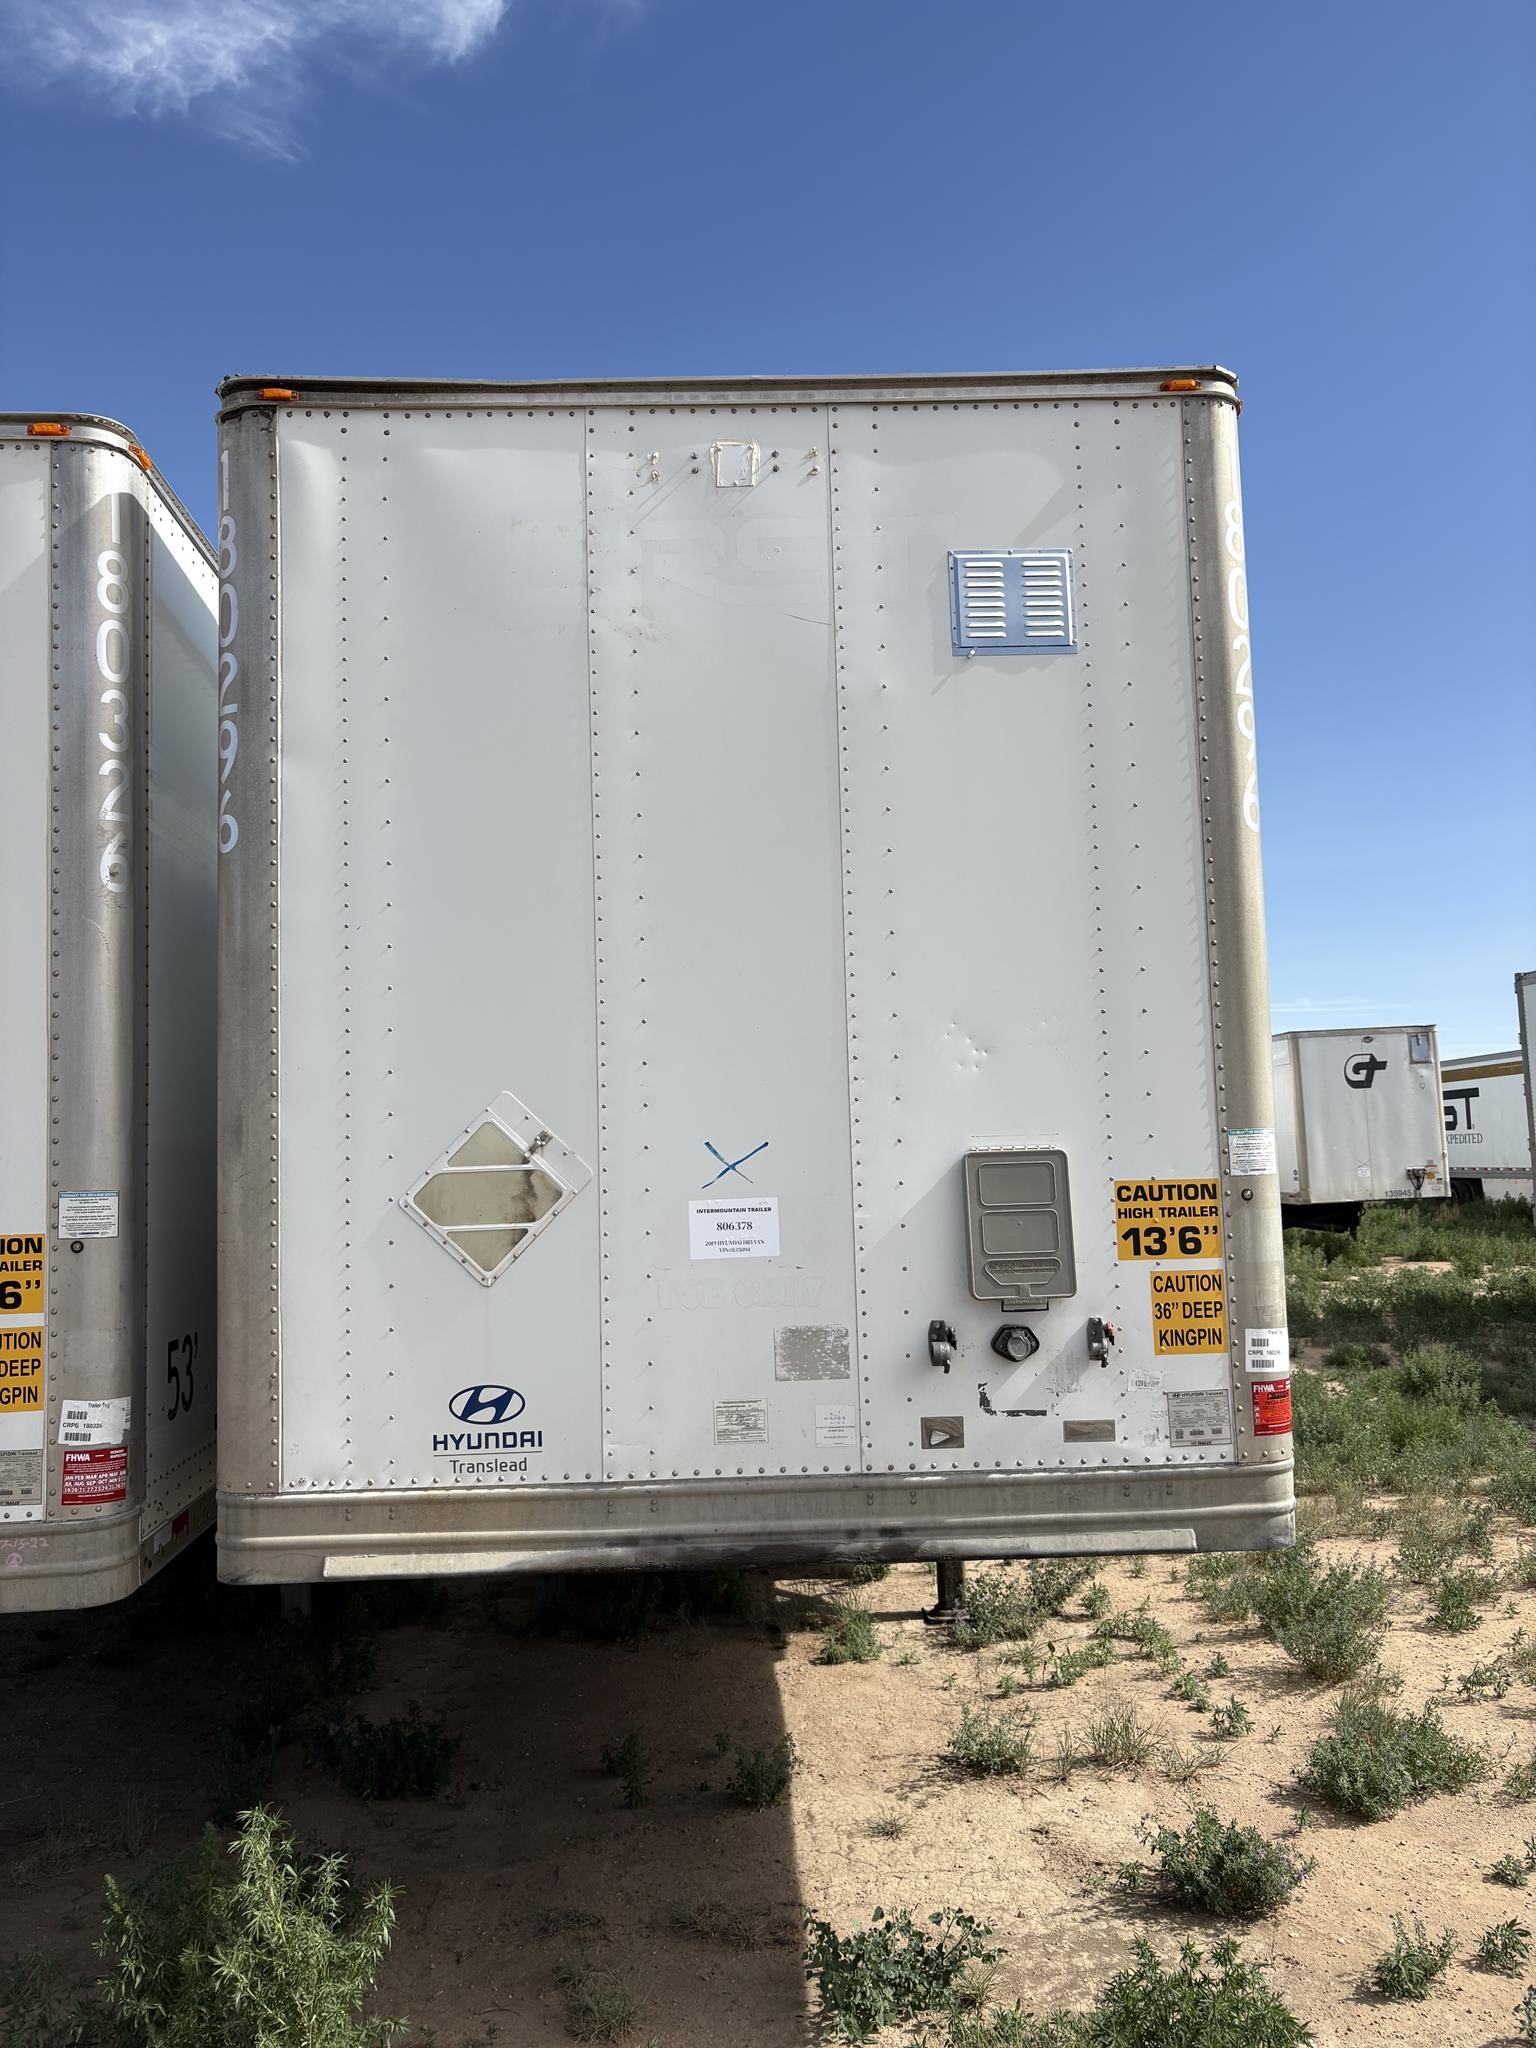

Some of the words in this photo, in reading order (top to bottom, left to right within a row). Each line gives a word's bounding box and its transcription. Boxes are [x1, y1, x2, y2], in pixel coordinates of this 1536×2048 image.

[96, 494, 131, 892] 180326
[1116, 1184, 1217, 1201] CAUTION
[1118, 1207, 1153, 1219] HIGH
[1159, 1206, 1219, 1217] TRAILER
[716, 1221, 753, 1231] 806378
[1153, 1274, 1222, 1293] CAUTION
[1182, 1301, 1223, 1319] DEEP
[0, 1331, 42, 1350] TION
[1159, 1328, 1222, 1347] KINGPIN
[1253, 1384, 1275, 1393] FHWA
[433, 1431, 543, 1451] HYUNDAI
[65, 1453, 91, 1461] FHWA
[449, 1457, 527, 1473] Translead
